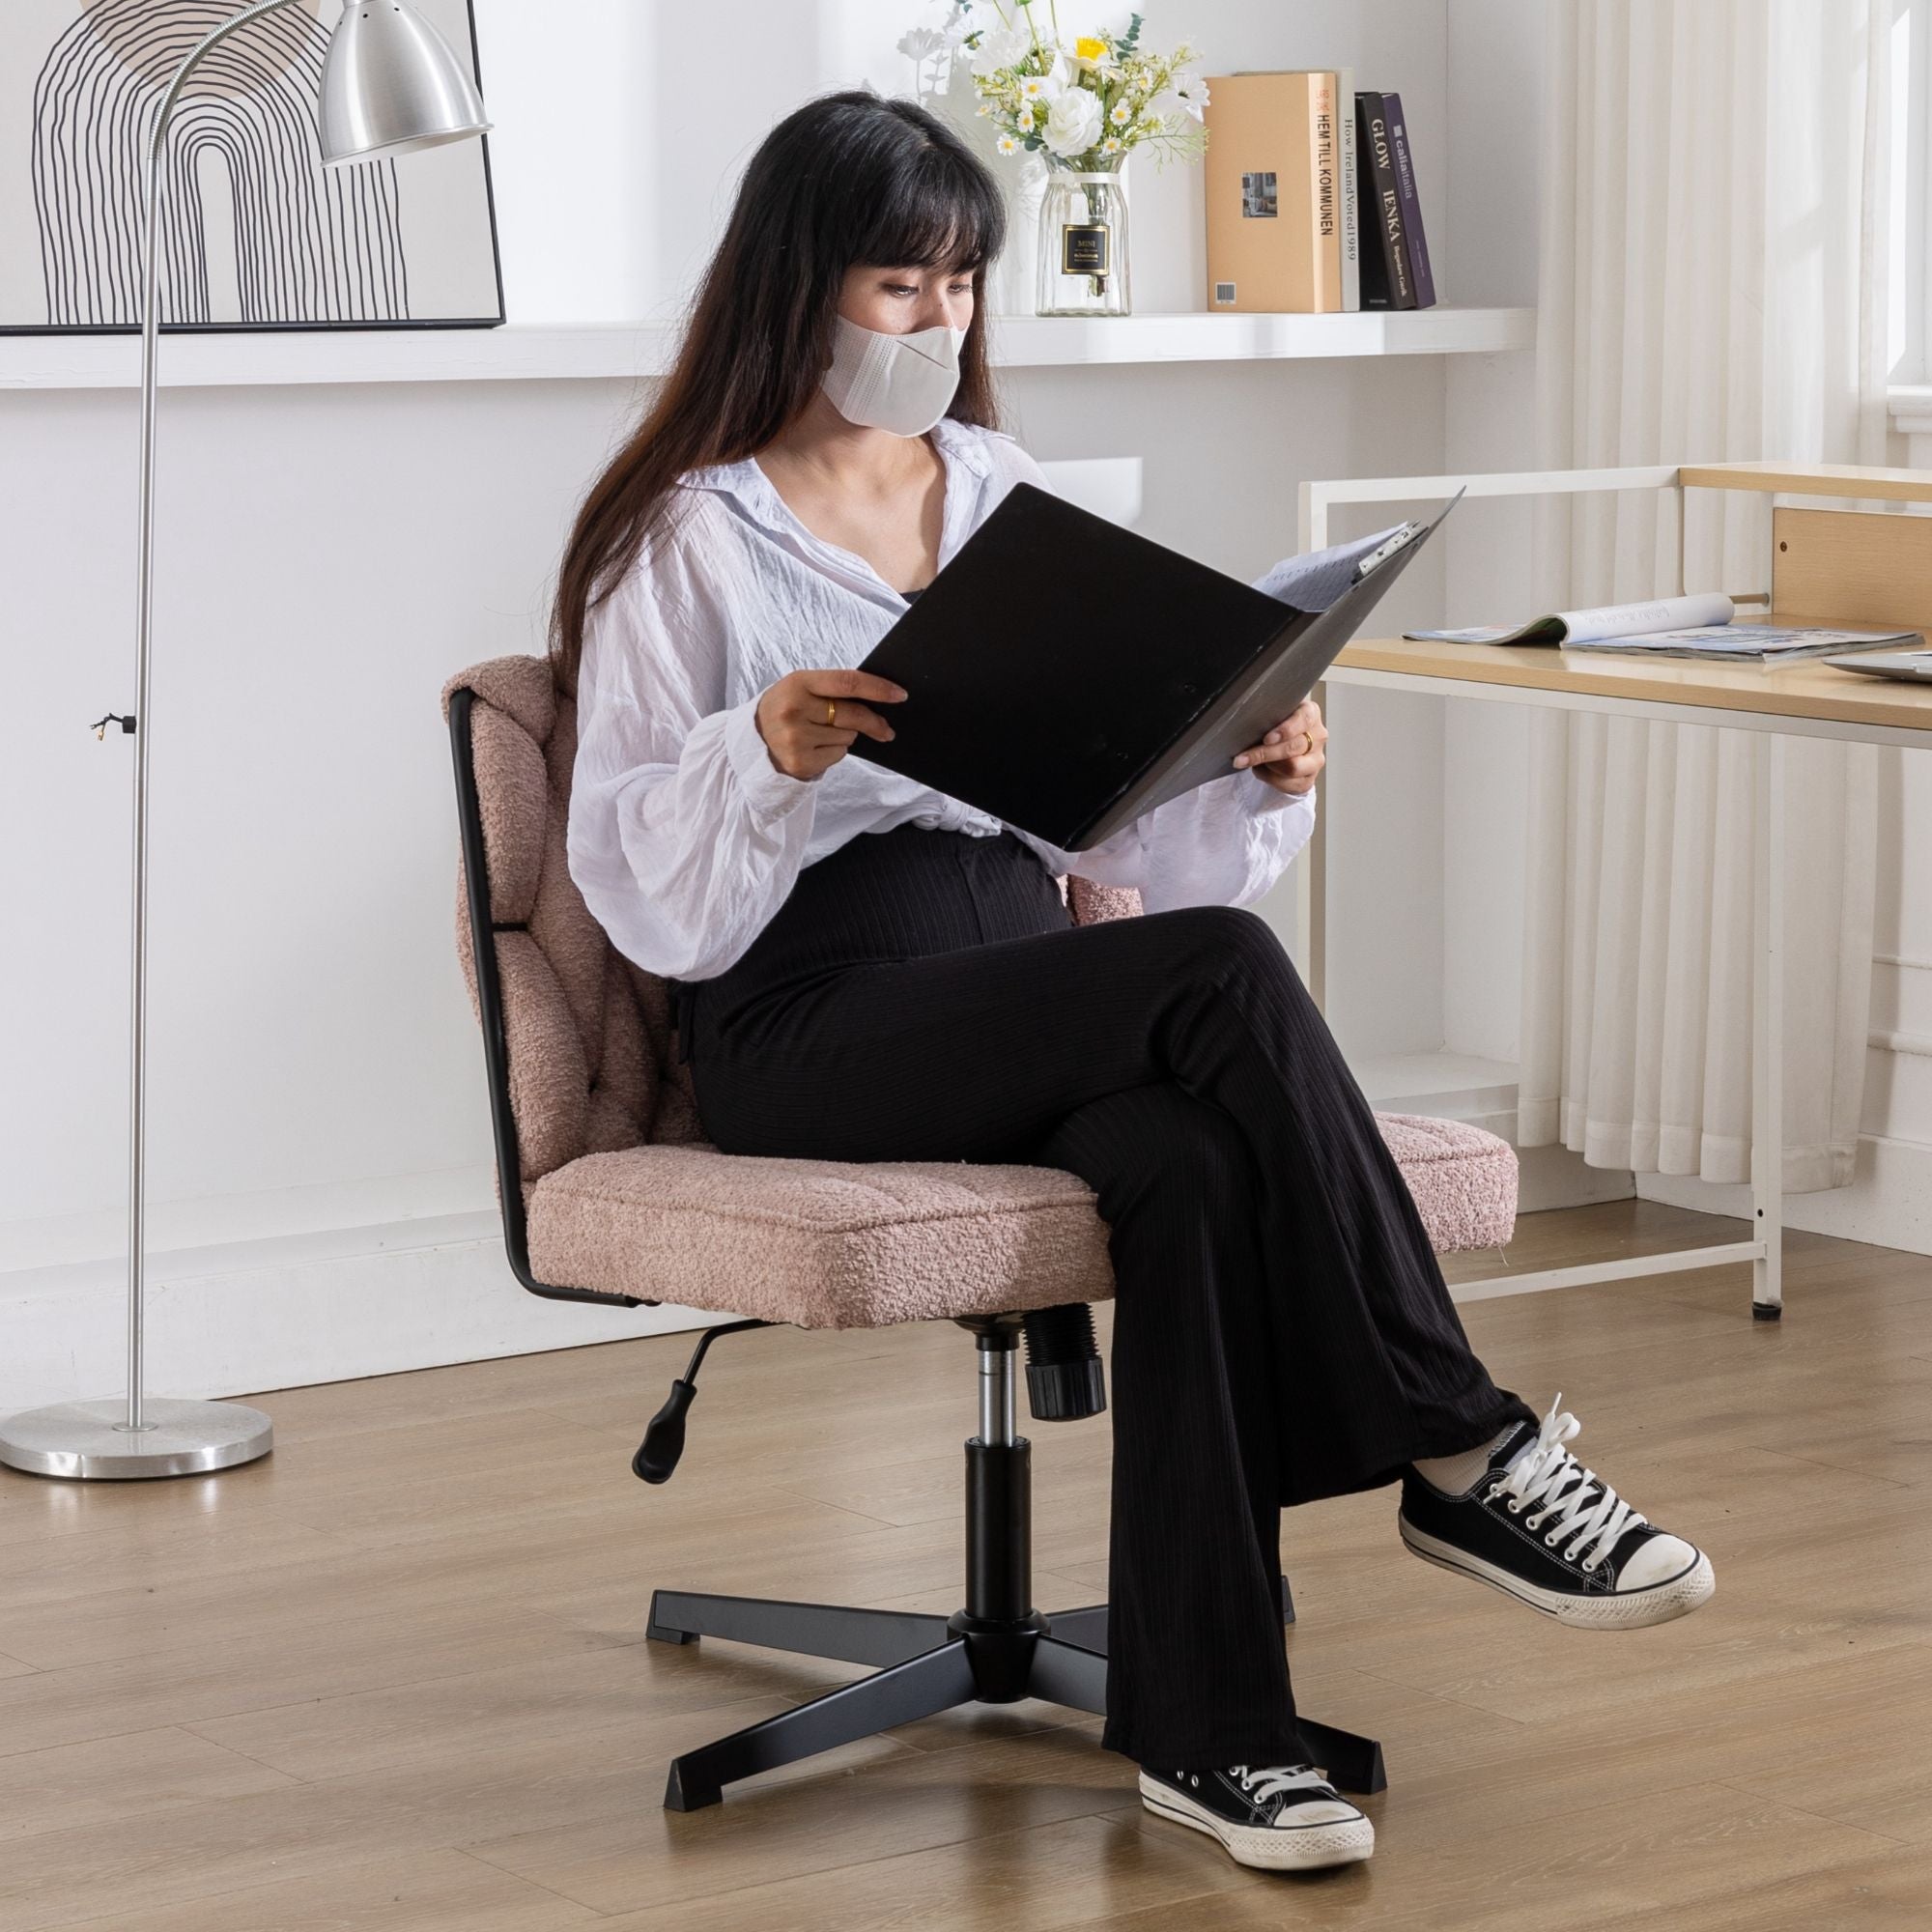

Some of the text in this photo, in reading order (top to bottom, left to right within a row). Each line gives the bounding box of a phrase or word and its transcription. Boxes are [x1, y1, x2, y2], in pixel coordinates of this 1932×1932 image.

[1318, 115, 1330, 139] HEM
[1345, 119, 1353, 147] How
[1318, 142, 1332, 166] TILL
[1372, 118, 1391, 169] GLOW
[1319, 169, 1333, 236] KOMMUNEN
